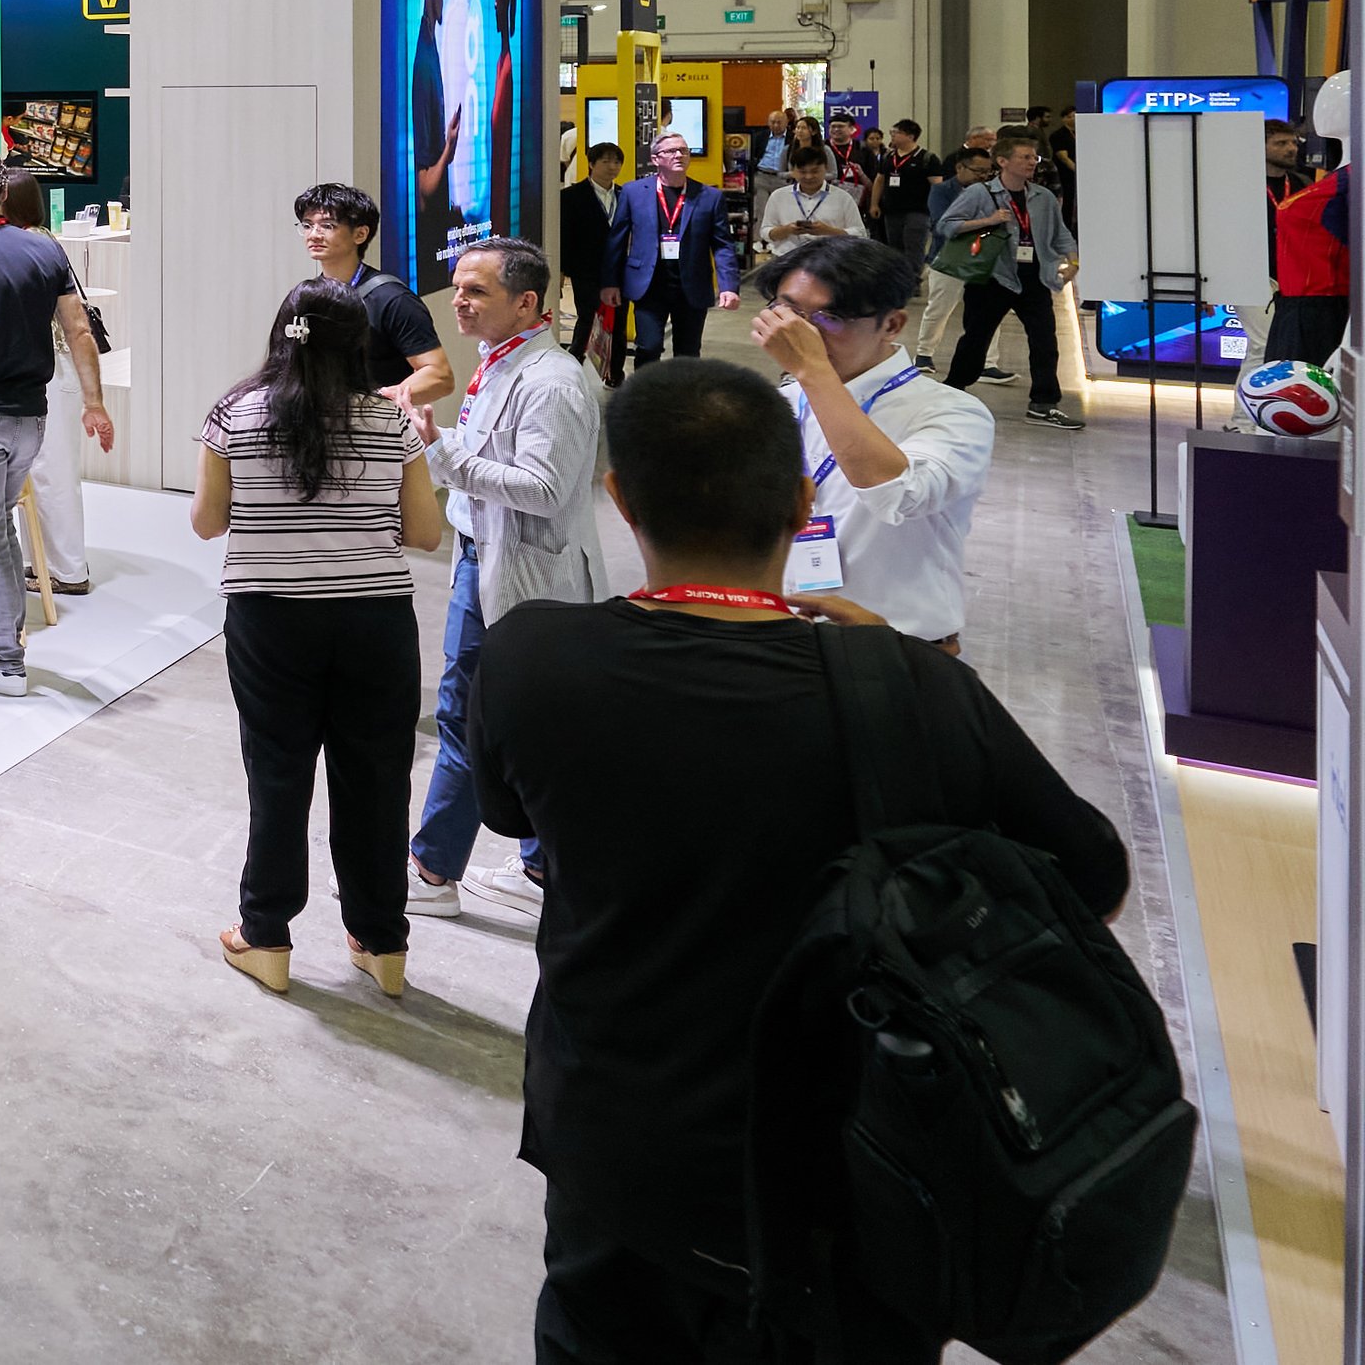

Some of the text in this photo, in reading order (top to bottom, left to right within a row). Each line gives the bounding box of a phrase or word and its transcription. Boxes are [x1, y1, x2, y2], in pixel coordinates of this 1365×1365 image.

[730, 13, 748, 21] EXIT
[1145, 93, 1187, 107] ETP
[830, 106, 872, 117] EXIT
[686, 589, 725, 600] PACIFIC
[727, 594, 749, 602] ASIA
